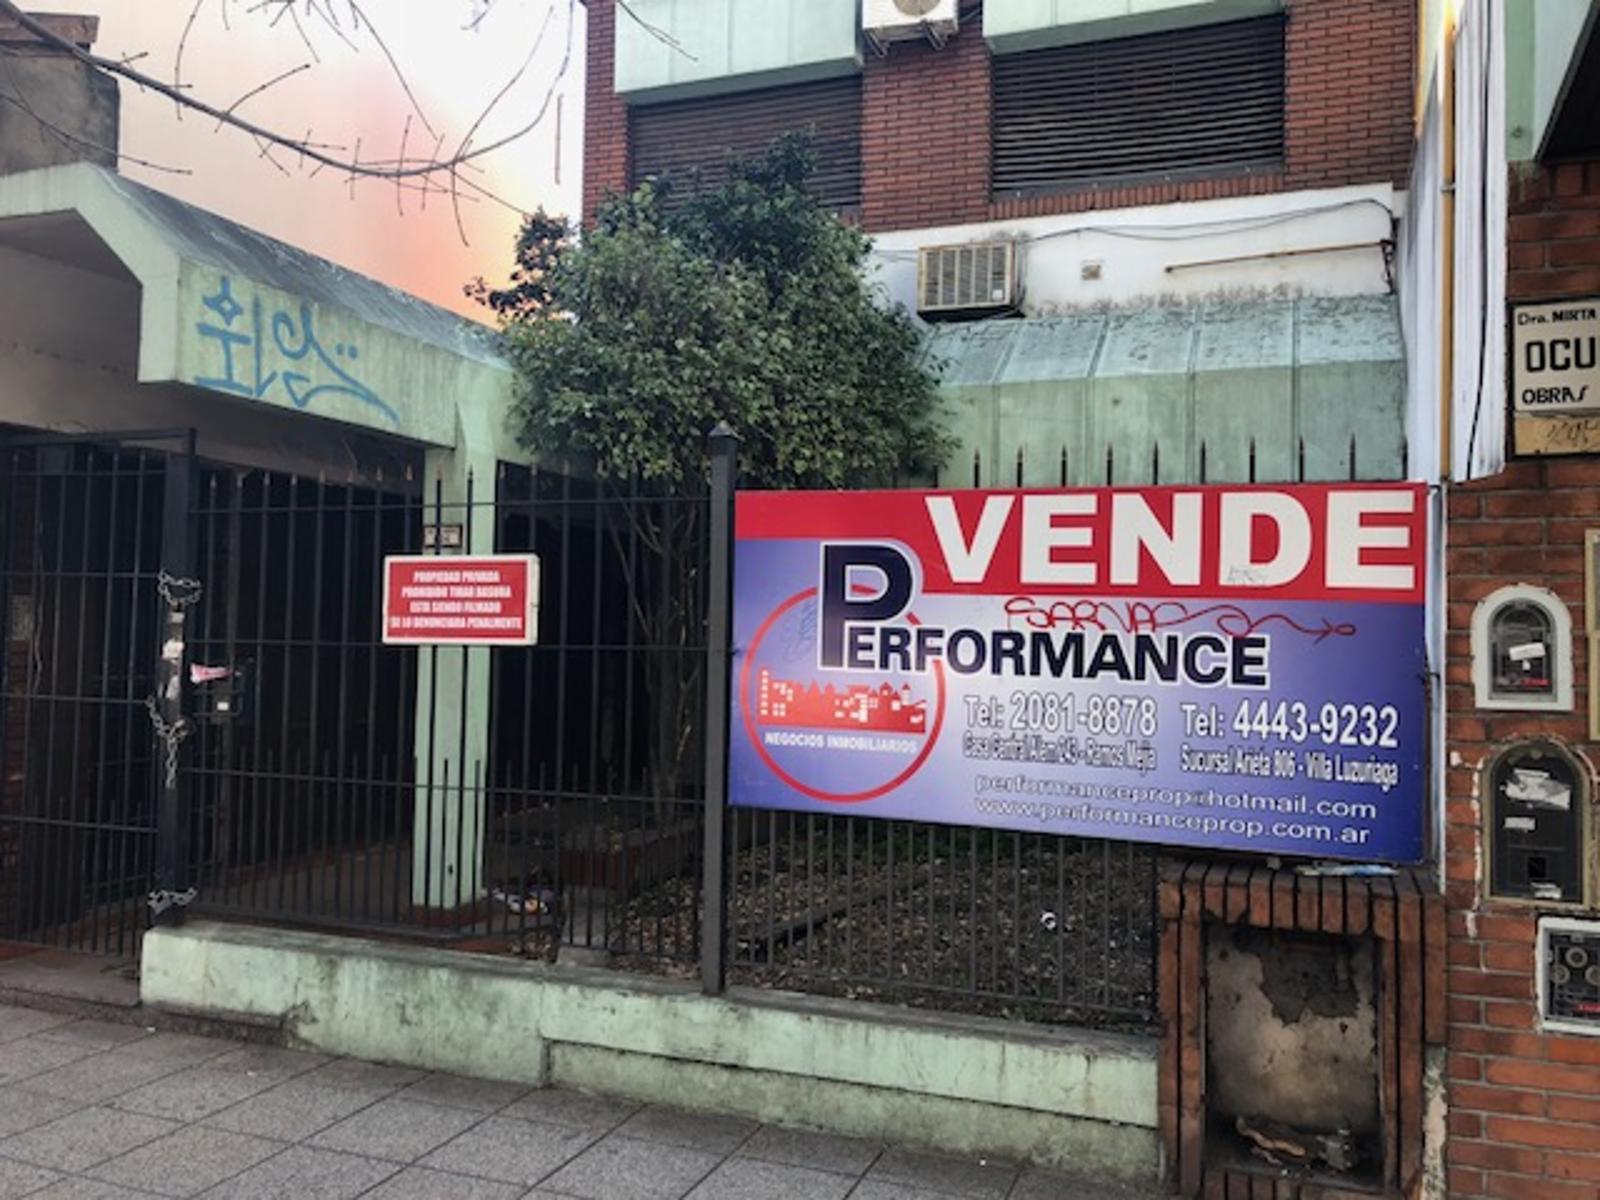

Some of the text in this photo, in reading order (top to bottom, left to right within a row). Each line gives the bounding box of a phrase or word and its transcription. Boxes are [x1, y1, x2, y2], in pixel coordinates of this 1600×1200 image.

[1517, 308, 1597, 326] Dra. MIRTA
[1525, 335, 1597, 373] OCU
[1521, 385, 1589, 405] OBRAS
[924, 490, 1416, 590] VENDE
[818, 538, 1272, 690] PERFORMANCE
[963, 689, 1158, 737] Tel: 2081-8878
[1181, 699, 1399, 749] Tel: 4443-9232
[764, 731, 918, 755] NEGOCIOS INMOBILIARIOS
[1180, 744, 1232, 773] Sucursal
[1305, 750, 1333, 781] Villa
[975, 796, 1371, 844] www.performanceprop.com.ar
